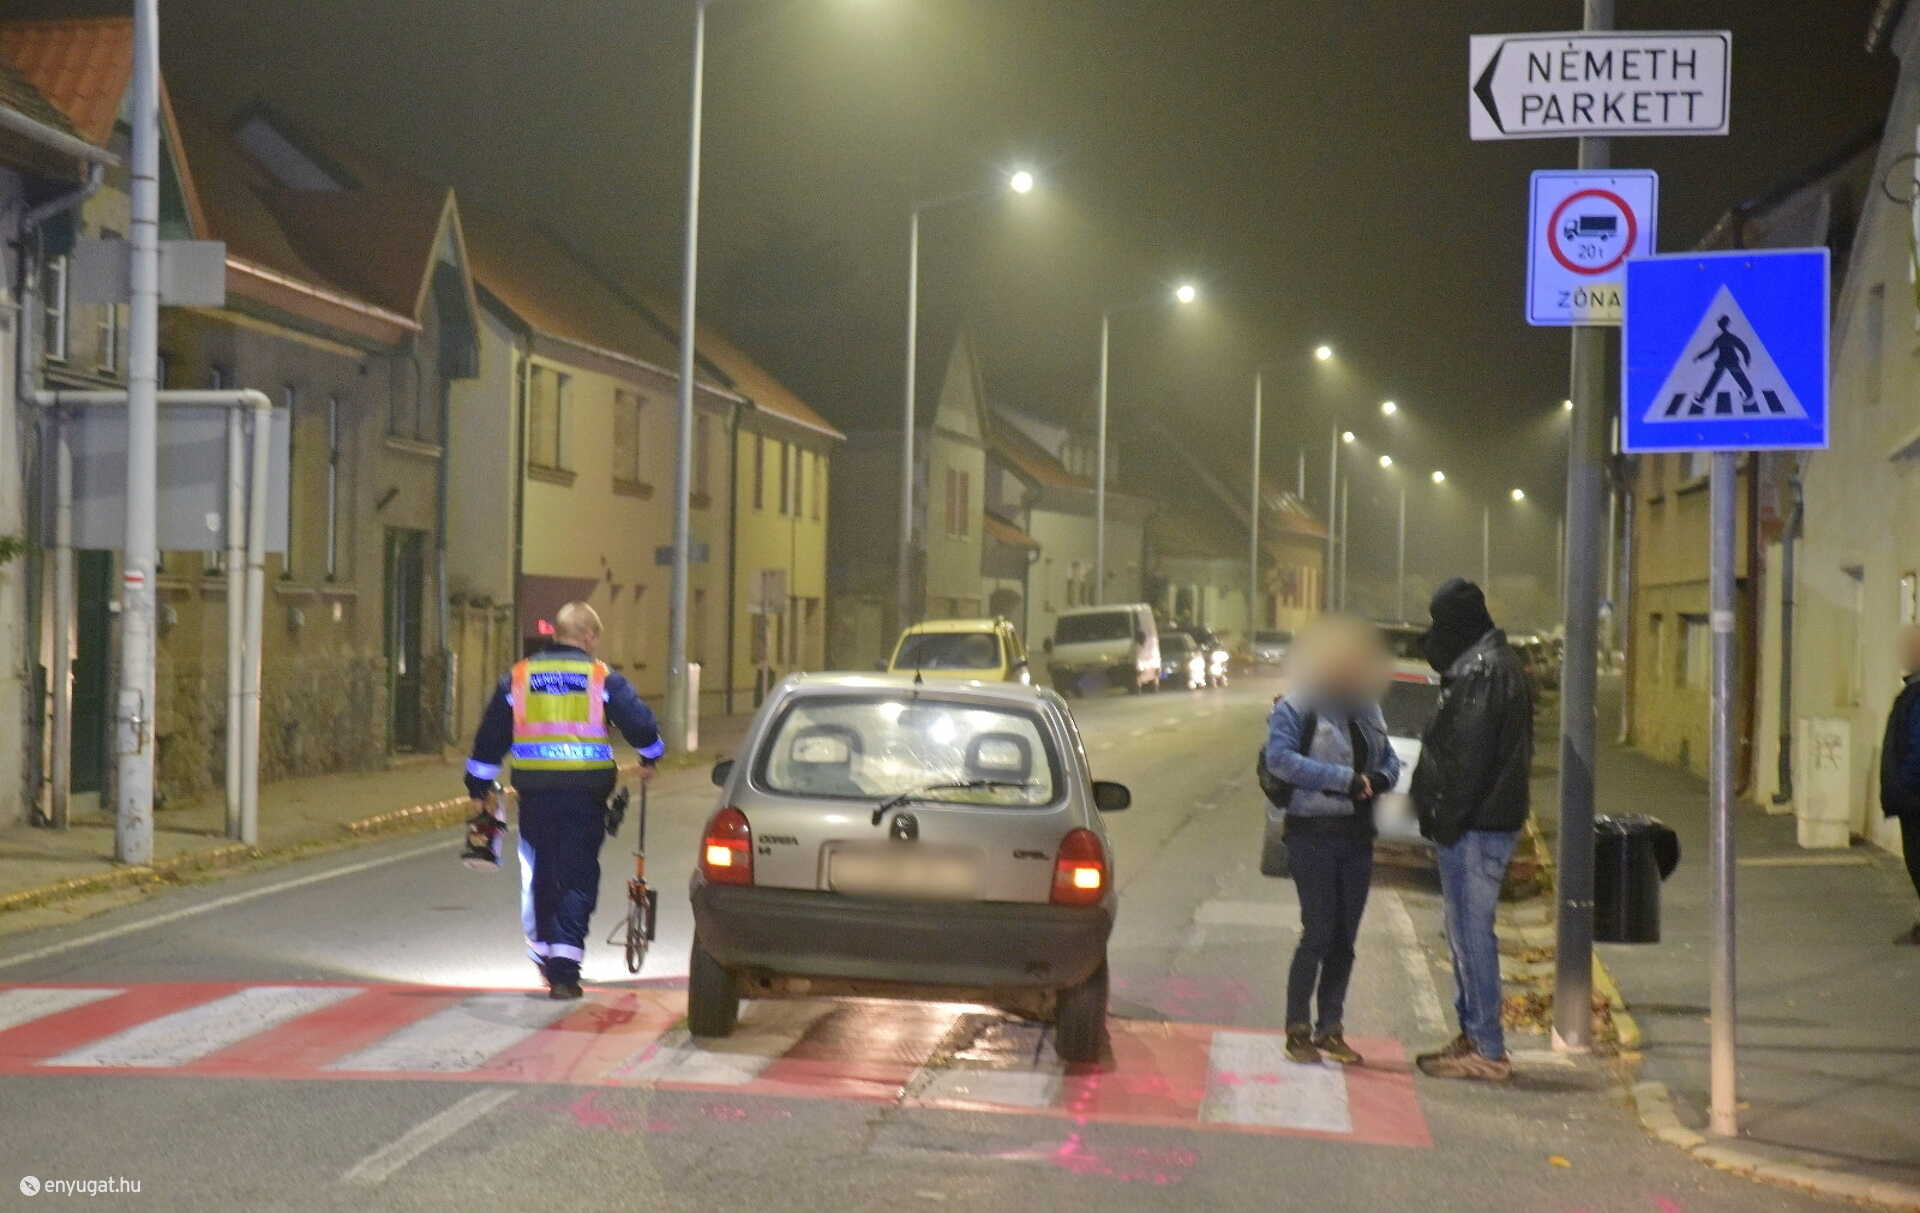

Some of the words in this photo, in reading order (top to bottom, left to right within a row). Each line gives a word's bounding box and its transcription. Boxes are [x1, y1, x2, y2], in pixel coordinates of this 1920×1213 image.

[1528, 42, 1696, 82] NÉMETH
[1521, 91, 1704, 126] PARKETT
[1557, 286, 1622, 308] ZÓNA
